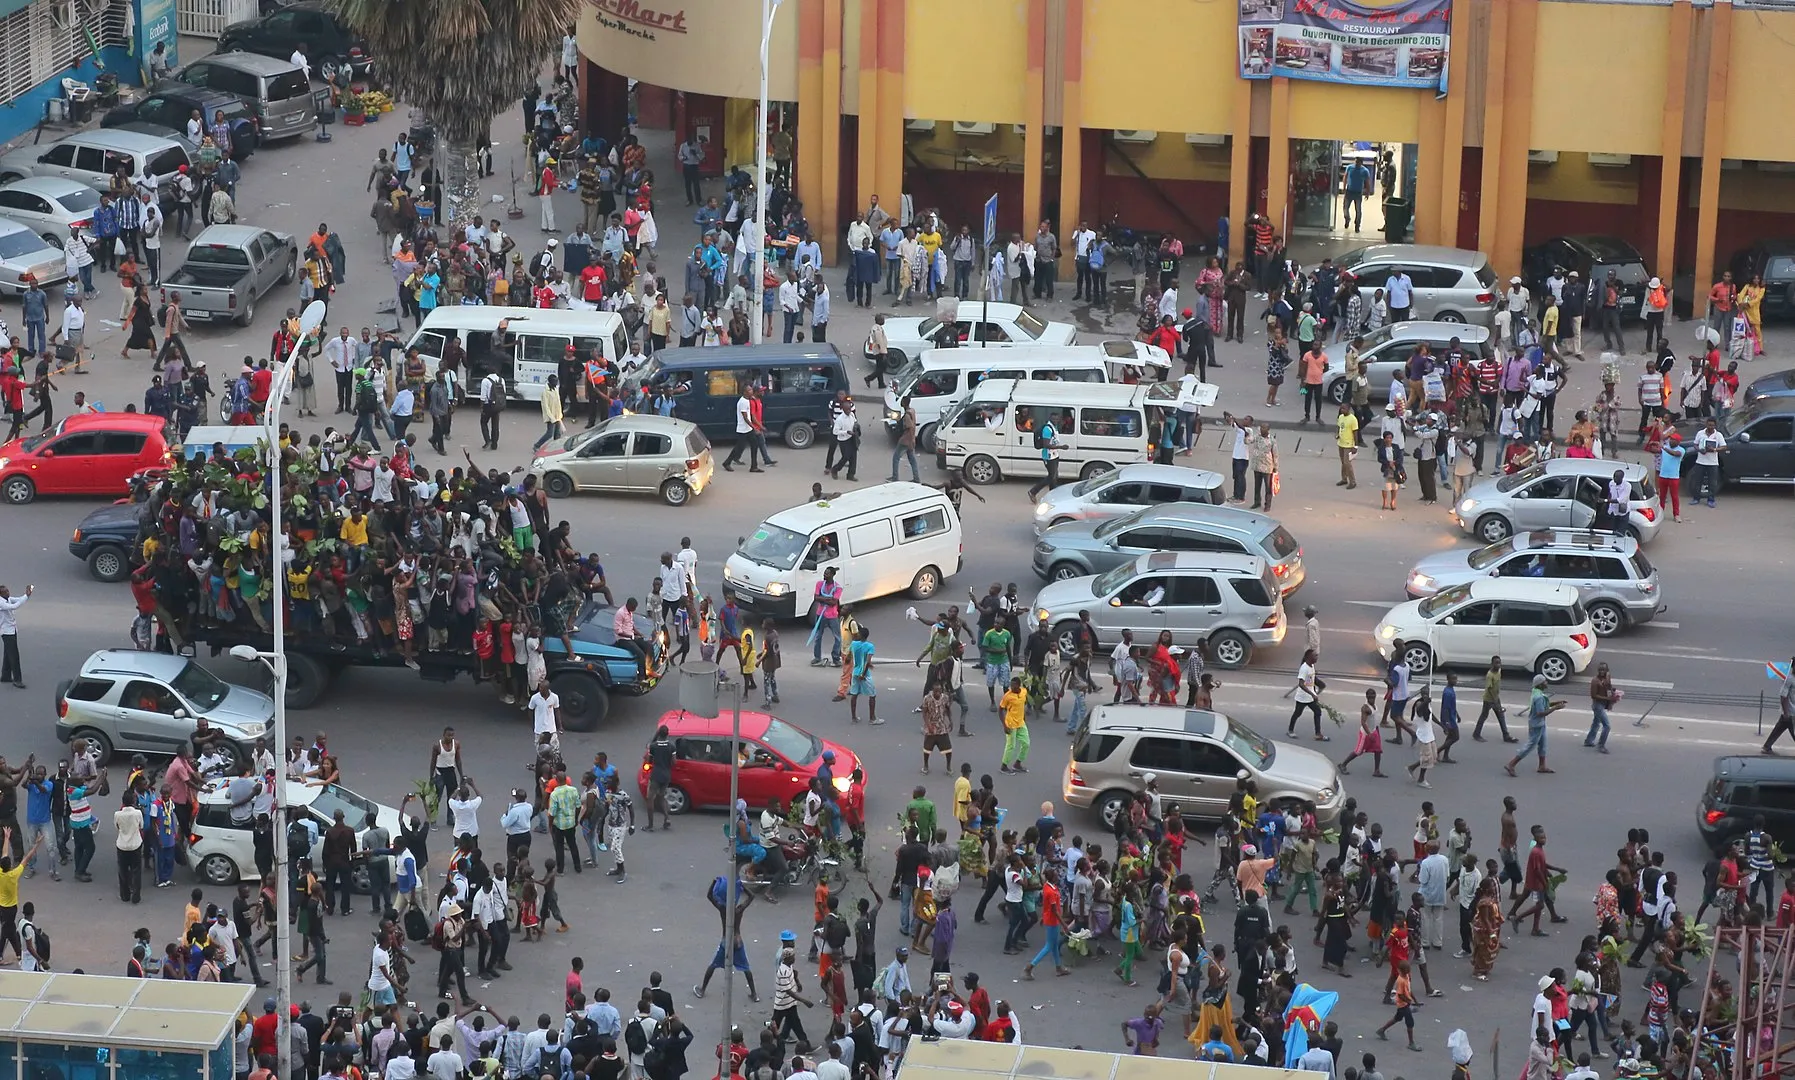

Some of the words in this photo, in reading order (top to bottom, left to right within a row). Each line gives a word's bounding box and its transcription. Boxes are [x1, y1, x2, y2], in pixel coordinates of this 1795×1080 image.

[149, 20, 169, 40] Ecobank
[1302, 28, 1346, 43] Ouverture
[1348, 35, 1357, 44] le
[1360, 37, 1369, 45] 14
[1420, 35, 1441, 46] 2015
[1343, 24, 1400, 34] RESTAURANT
